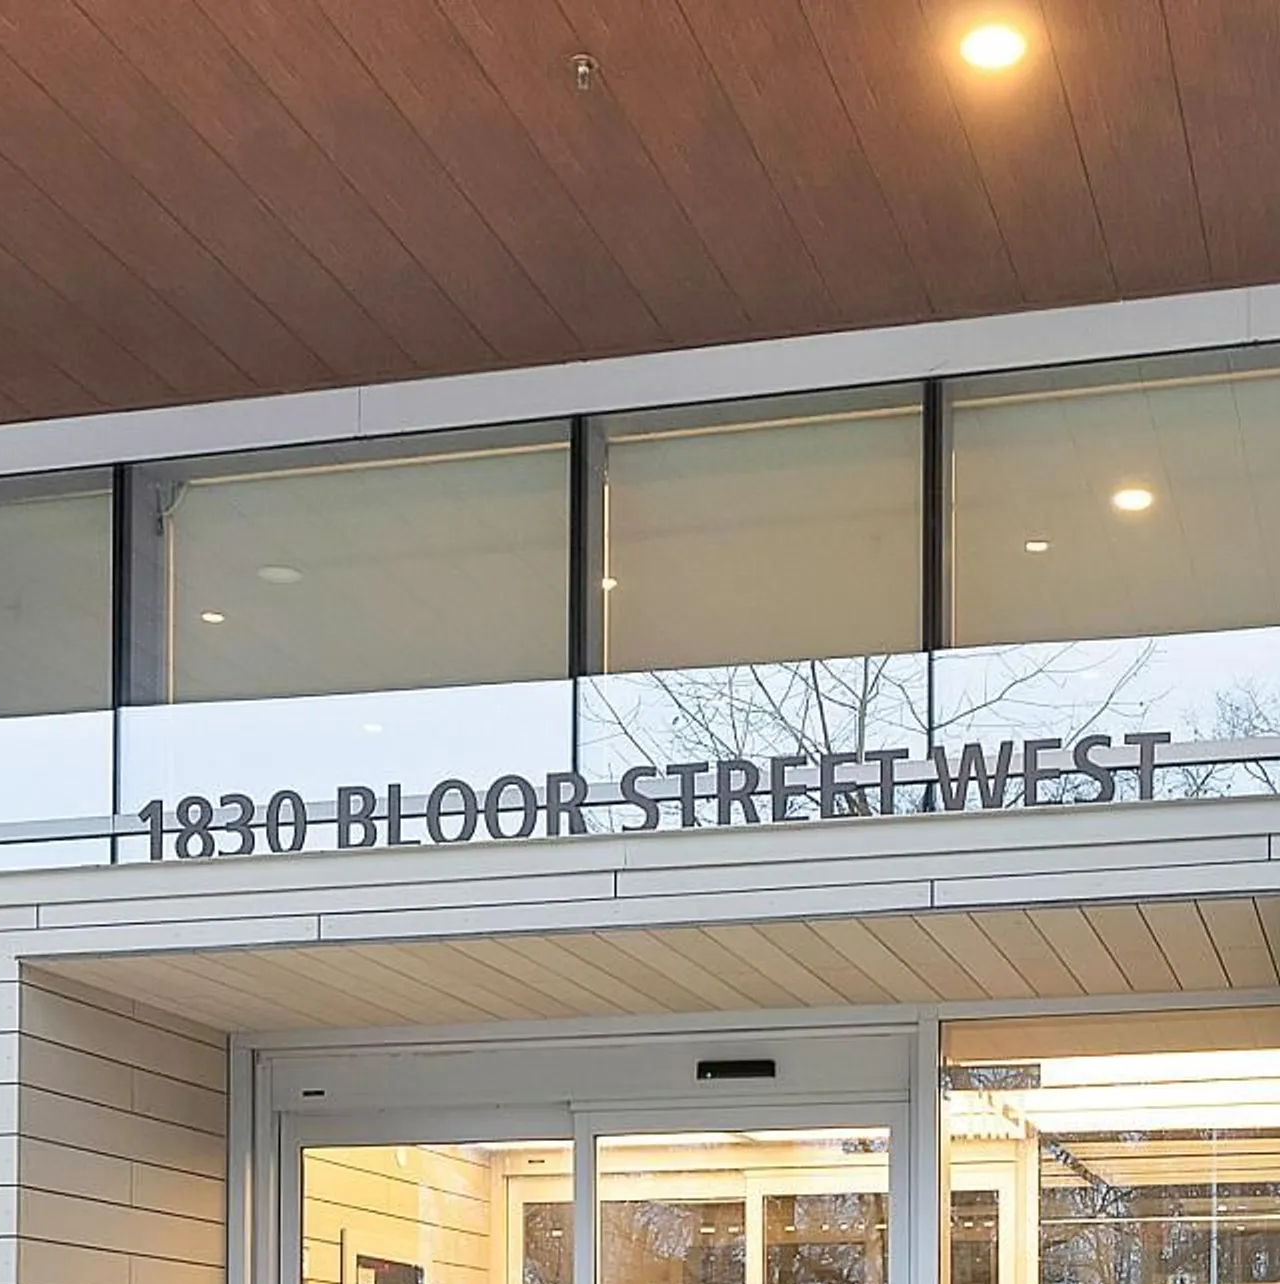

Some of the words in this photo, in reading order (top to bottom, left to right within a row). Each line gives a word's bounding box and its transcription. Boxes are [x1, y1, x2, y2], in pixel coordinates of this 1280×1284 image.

[137, 789, 307, 861] 1830
[337, 772, 589, 848] BLOOR
[619, 747, 909, 832] STREET
[933, 732, 1171, 811] WEST
